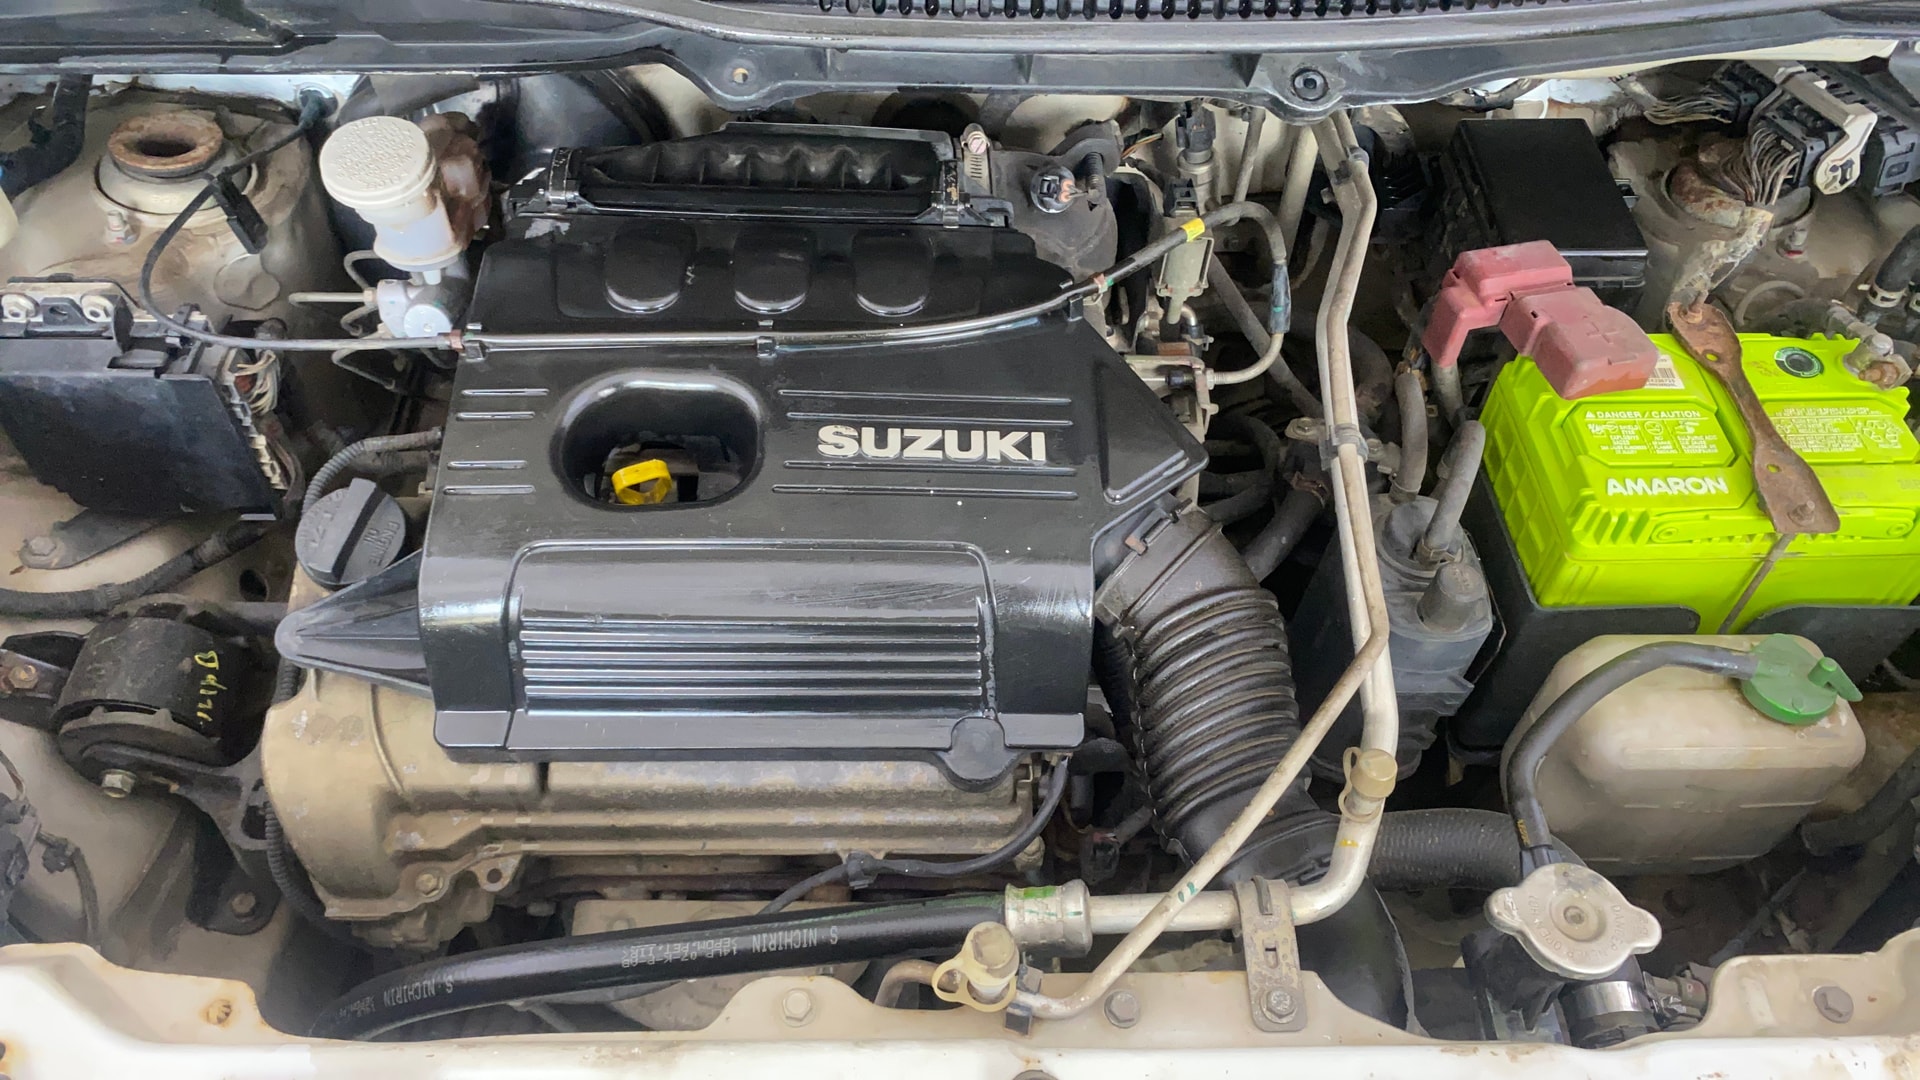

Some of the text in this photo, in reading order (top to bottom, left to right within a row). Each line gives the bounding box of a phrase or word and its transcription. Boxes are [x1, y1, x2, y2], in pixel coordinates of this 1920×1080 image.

[1597, 411, 1642, 419] DANGER
[1651, 410, 1701, 419] CAUTION
[817, 424, 1048, 466] SUZUKI
[1607, 477, 1729, 496] AMARON
[368, 520, 400, 567] ENGINE
[752, 927, 818, 954] NICHIRIN
[383, 978, 436, 1008] NICHIRIN
